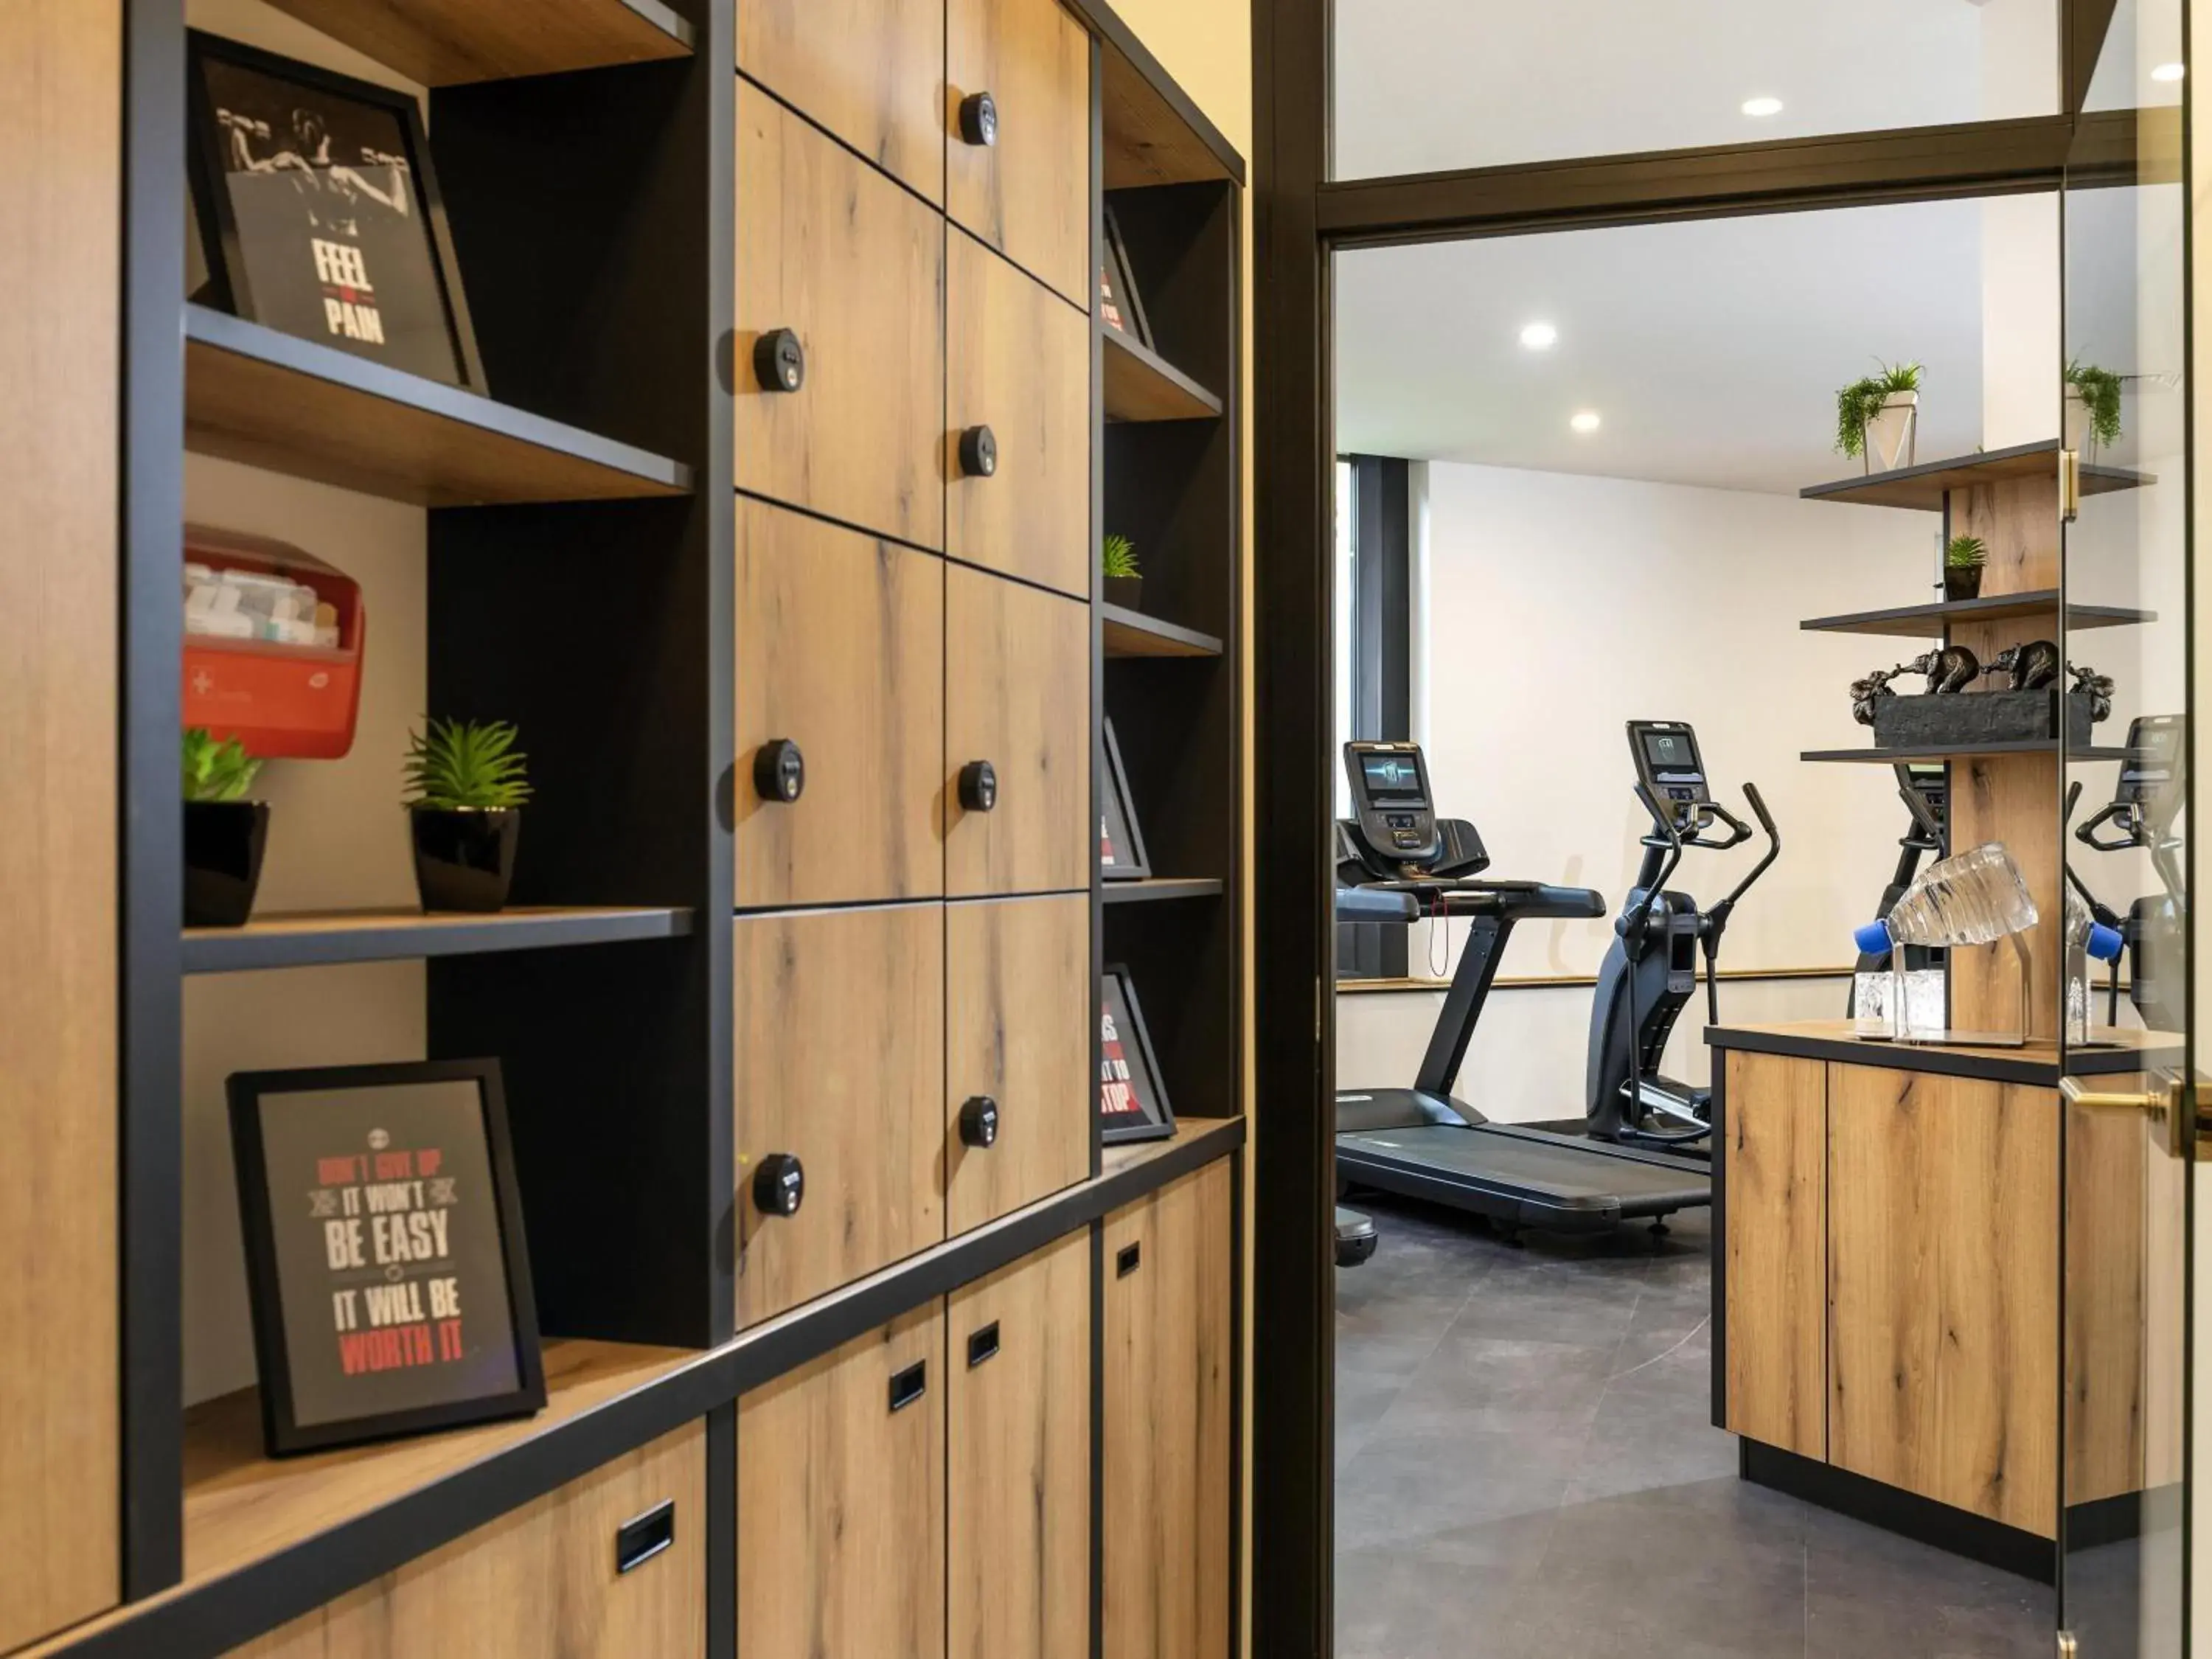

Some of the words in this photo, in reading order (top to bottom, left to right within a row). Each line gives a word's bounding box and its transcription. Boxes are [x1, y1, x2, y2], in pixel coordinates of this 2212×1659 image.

[310, 237, 374, 292] FEEL
[323, 297, 386, 345] PAIN
[342, 1186, 361, 1217] IT
[364, 1180, 425, 1214] WON'T
[324, 1218, 365, 1270] BE
[372, 1208, 448, 1265] EASY
[333, 1289, 357, 1332] IT
[364, 1281, 425, 1326] WILL
[428, 1276, 461, 1319] BE
[338, 1322, 434, 1376] WORTH
[439, 1318, 462, 1362] IT
